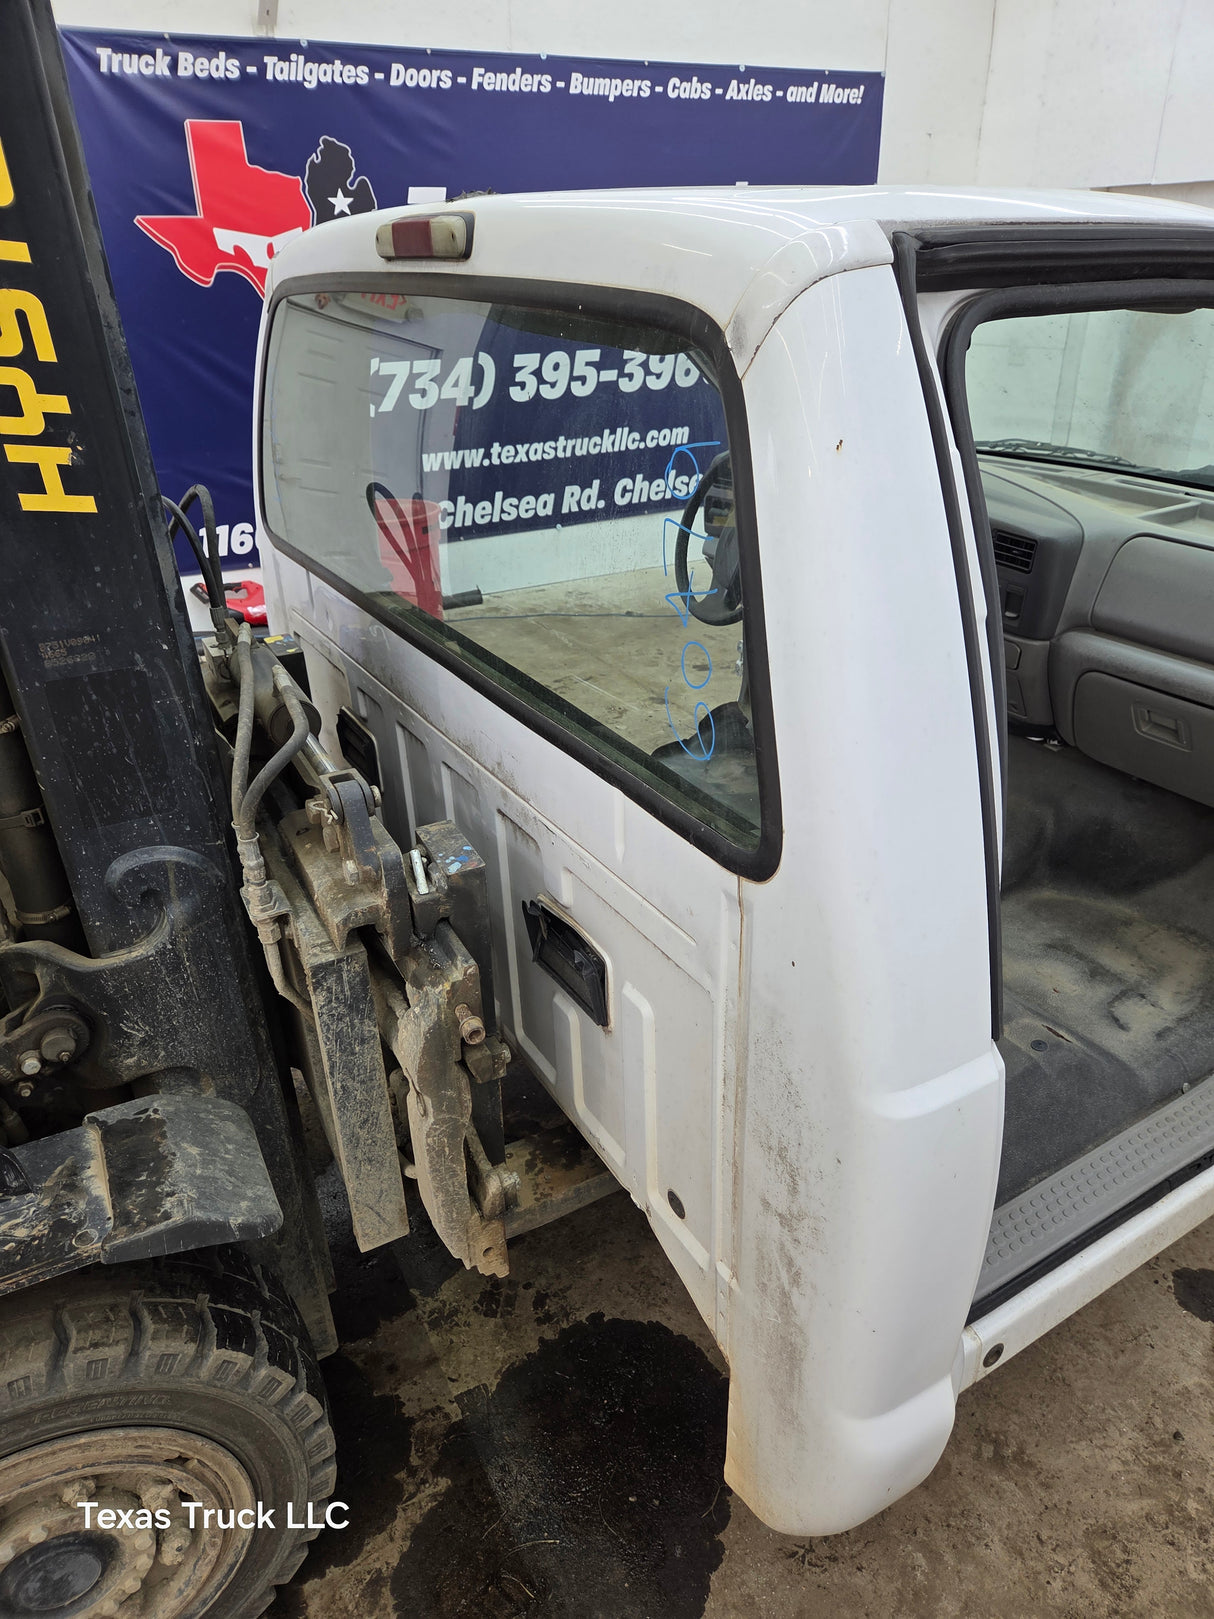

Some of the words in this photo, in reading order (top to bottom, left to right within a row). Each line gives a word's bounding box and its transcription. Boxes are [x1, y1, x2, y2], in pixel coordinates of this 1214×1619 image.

[96, 47, 171, 77] Truck
[177, 51, 241, 79] Beds
[263, 54, 370, 88] Tailgates
[389, 63, 453, 89] Doors
[471, 67, 553, 93] Fenders
[569, 72, 652, 102] Bumpers
[667, 76, 712, 100] Cabs
[725, 79, 774, 102] Axles
[786, 82, 818, 103] and
[818, 83, 865, 105] More!
[0, 138, 98, 513] HYS
[509, 349, 709, 402] 395-396
[421, 426, 690, 474] www.texastruckllc.com
[198, 522, 260, 559] 116
[438, 490, 555, 530] Chelsea
[561, 479, 606, 514] Rd.
